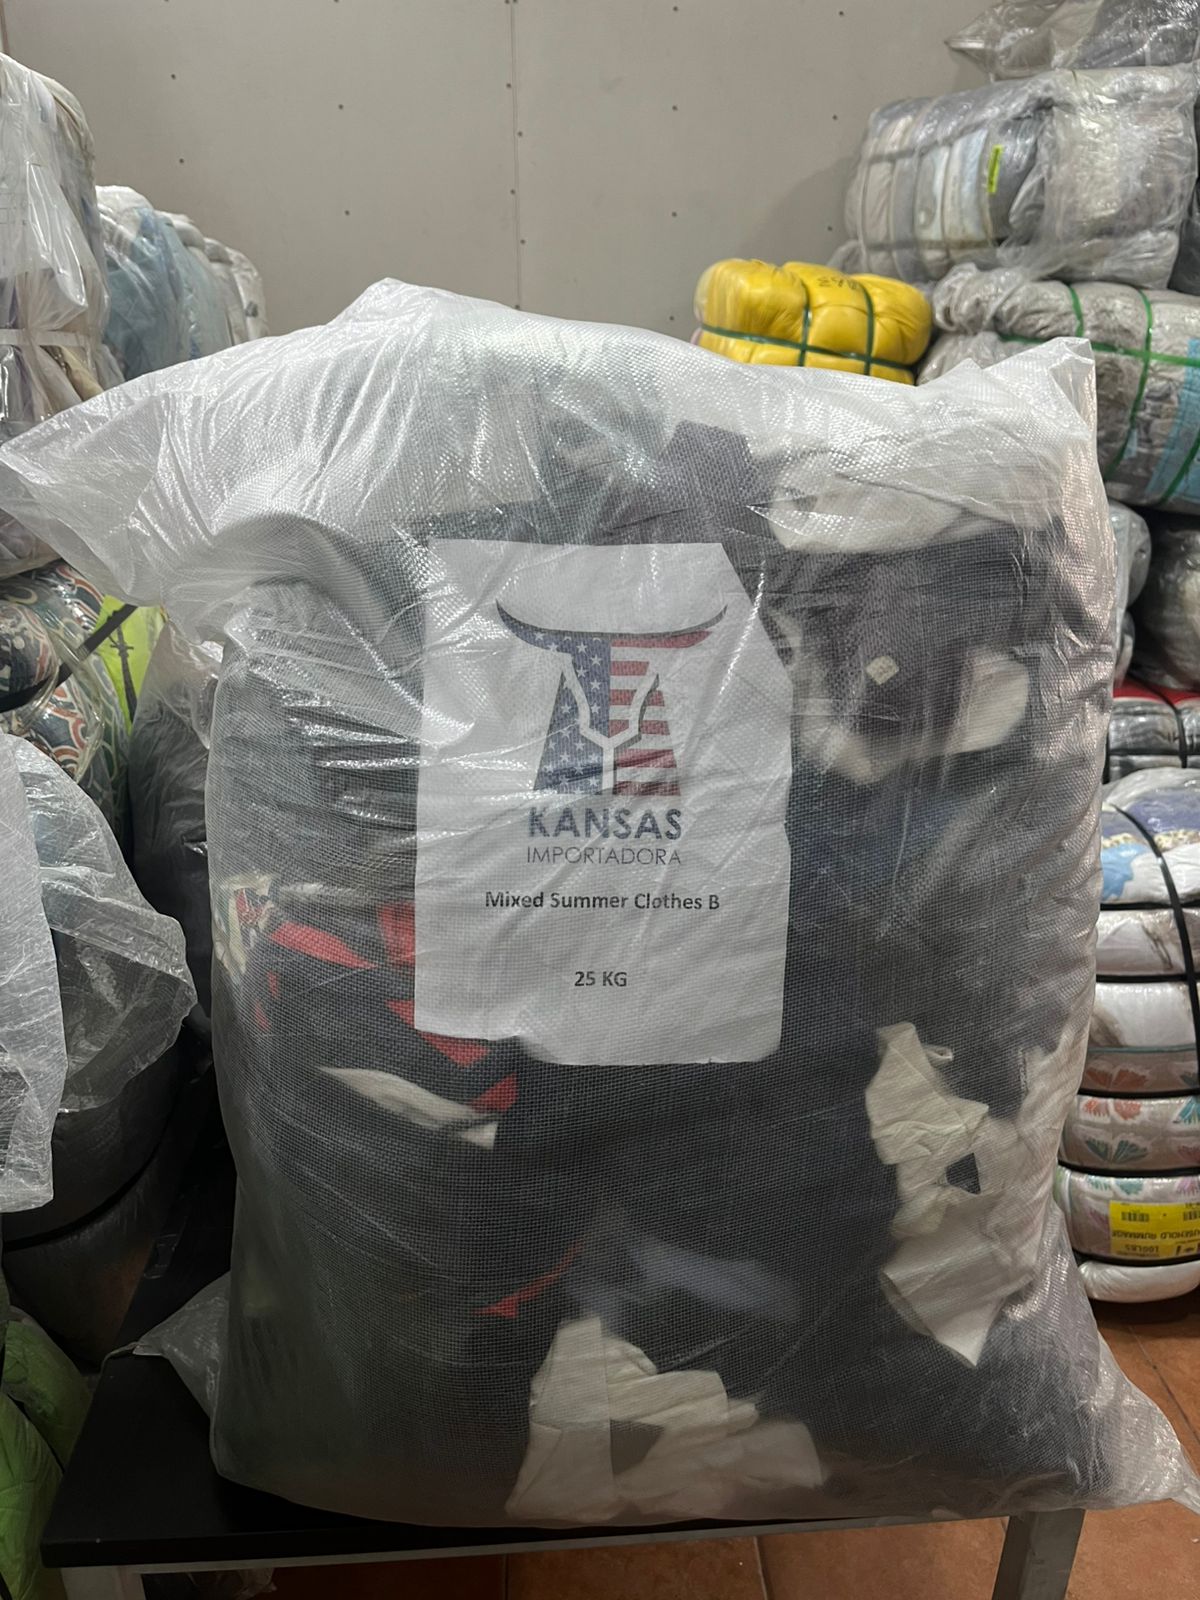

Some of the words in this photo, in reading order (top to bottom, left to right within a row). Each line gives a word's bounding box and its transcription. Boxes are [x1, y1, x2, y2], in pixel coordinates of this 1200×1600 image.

[527, 807, 682, 840] KANSAS
[526, 846, 682, 865] IMPORTADORA
[485, 890, 544, 909] Mixed
[550, 892, 628, 910] Summer
[634, 892, 702, 910] Clothes
[708, 894, 720, 910] B
[574, 971, 596, 987] 25
[602, 971, 628, 988] KG
